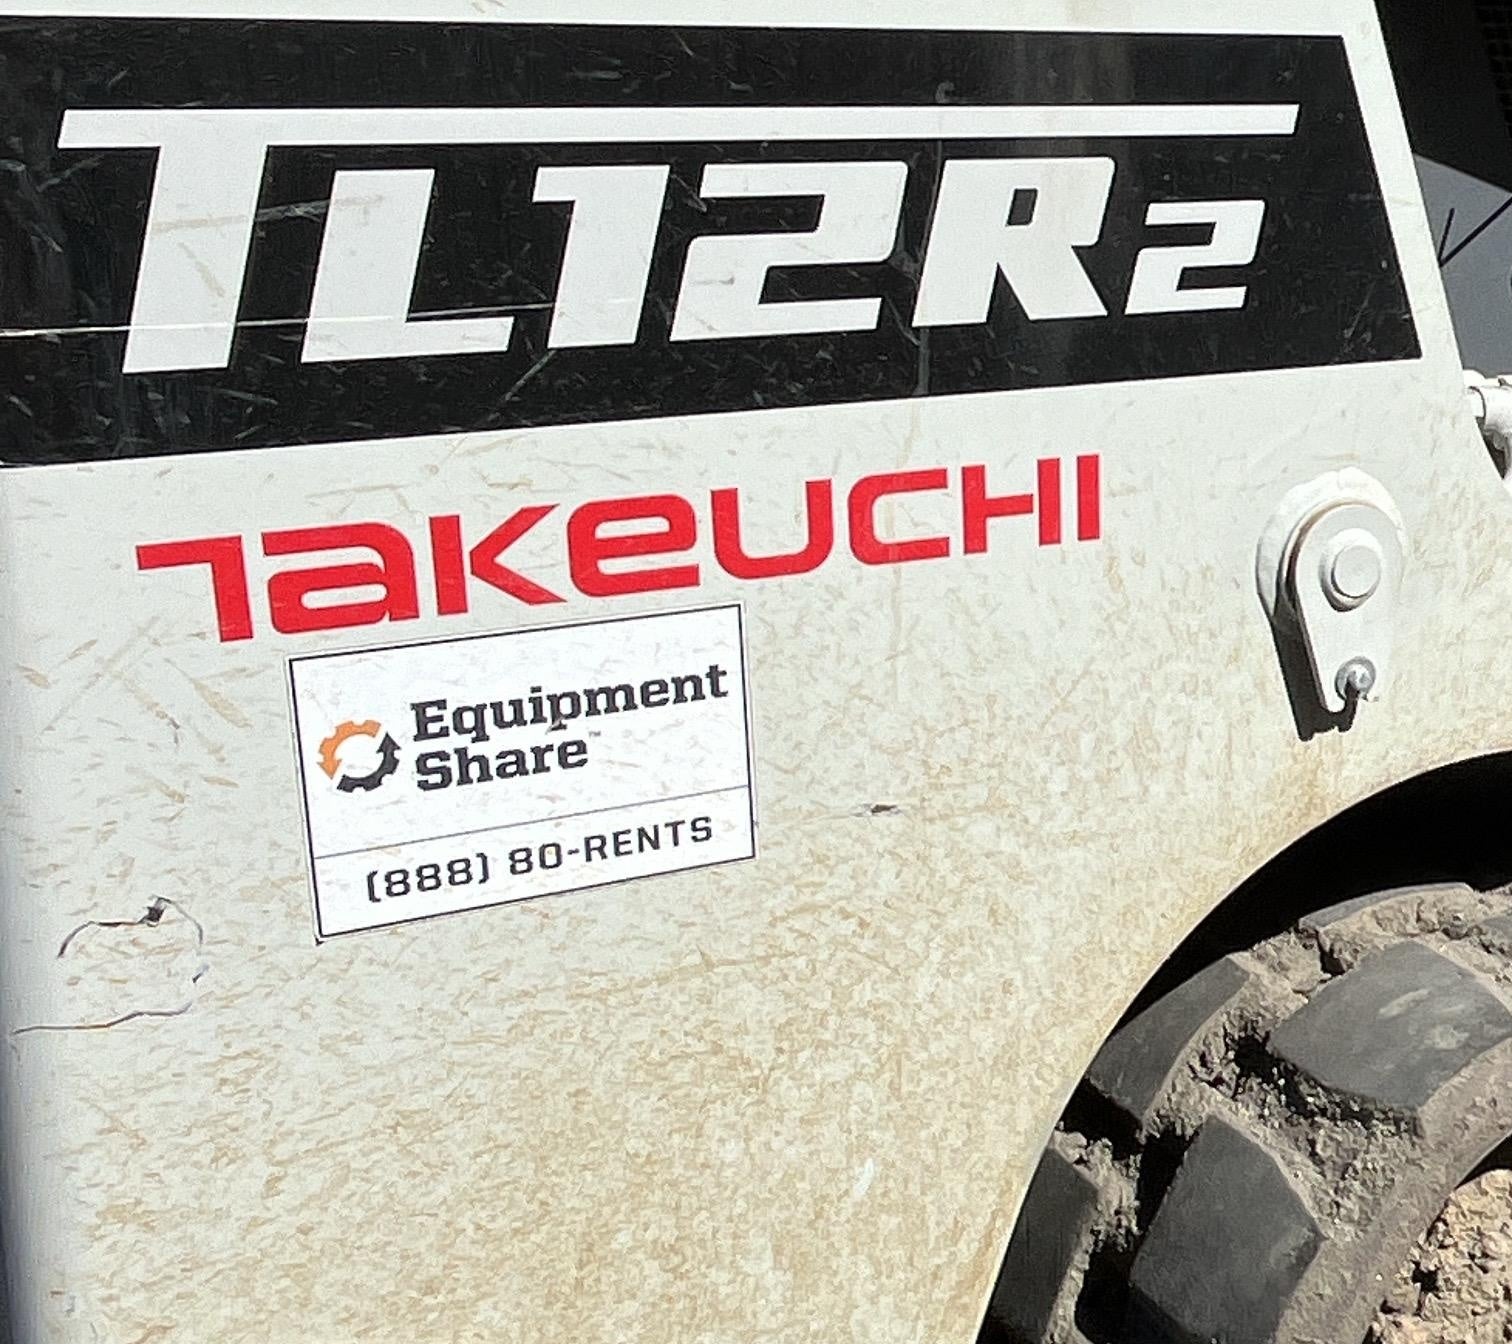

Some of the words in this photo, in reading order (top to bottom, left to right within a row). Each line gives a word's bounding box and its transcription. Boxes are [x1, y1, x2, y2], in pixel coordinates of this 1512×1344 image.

[57, 104, 1300, 374] TL12R2
[411, 664, 729, 744] Equipment
[367, 852, 490, 903] (888)
[508, 816, 713, 876] 80-RENTS
